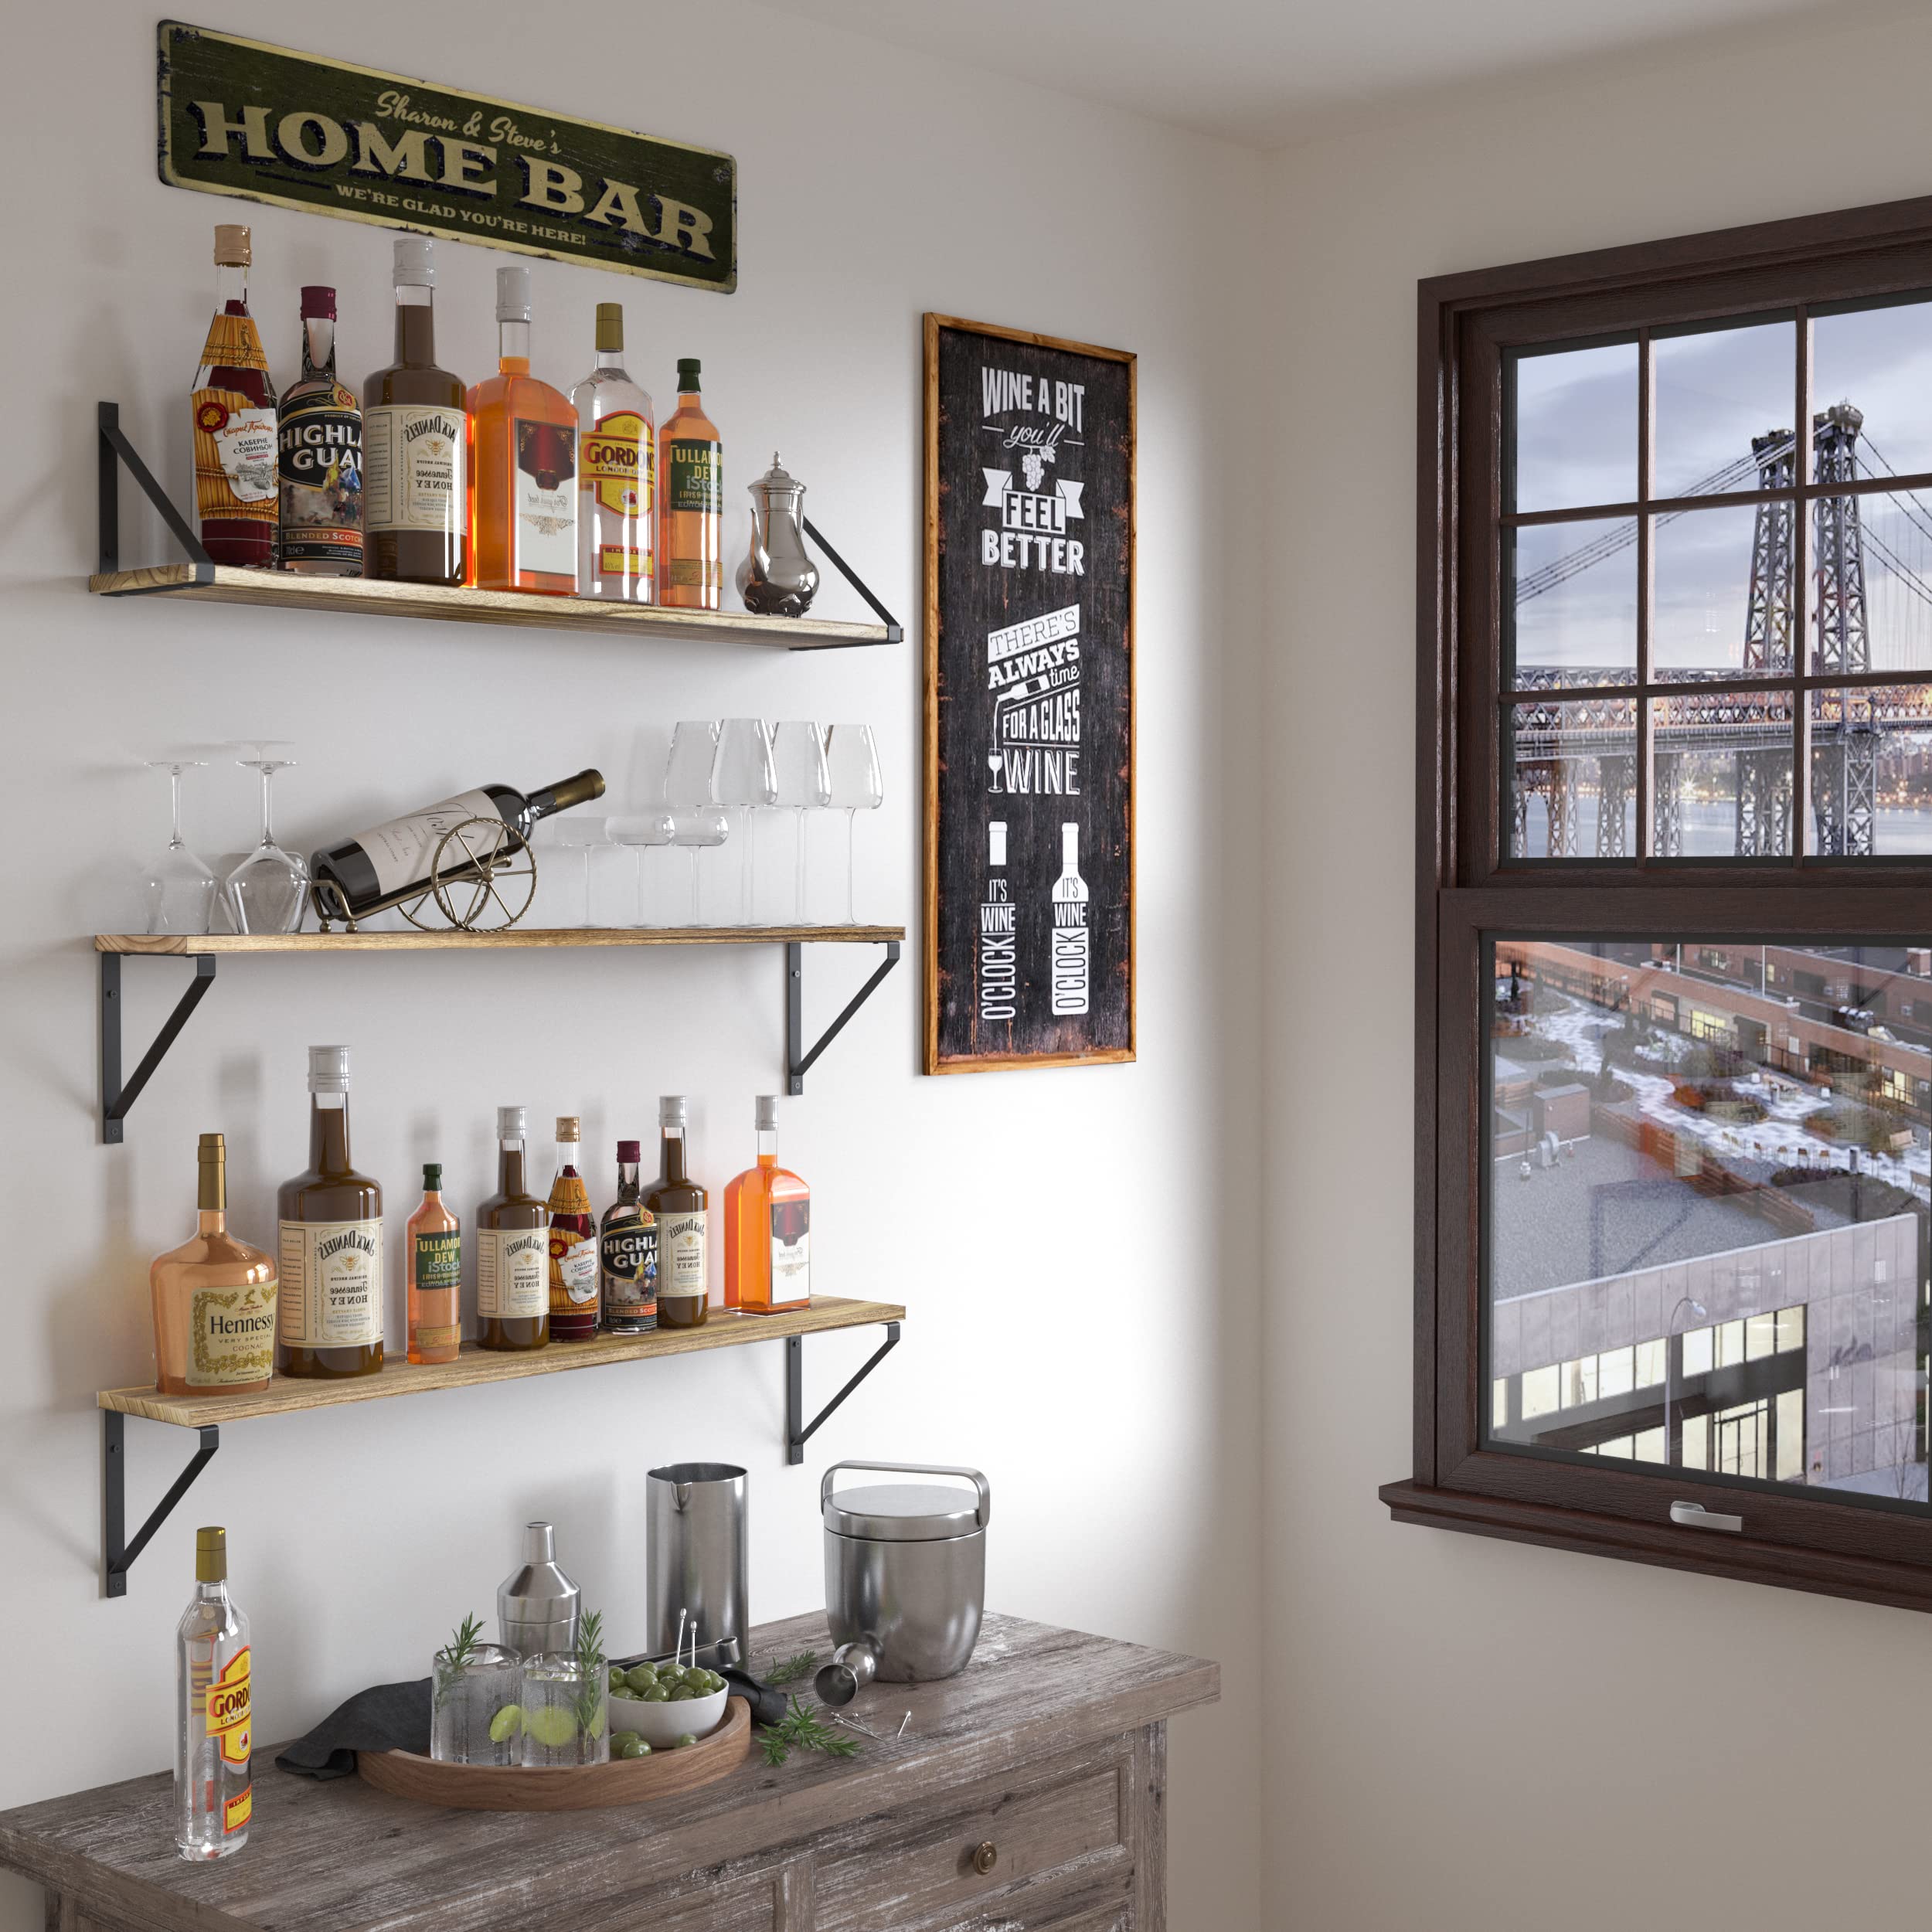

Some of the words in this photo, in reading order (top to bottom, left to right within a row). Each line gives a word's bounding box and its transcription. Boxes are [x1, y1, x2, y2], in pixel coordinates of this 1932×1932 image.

[375, 90, 457, 131] Sharon
[463, 111, 483, 137] &
[488, 117, 562, 155] Steve's
[192, 101, 497, 196] HOME
[515, 155, 717, 261] BAR
[335, 185, 399, 206] WE'RE
[403, 199, 455, 218] GLAD
[460, 209, 528, 232] YOU'RE
[531, 225, 586, 245] HERE!
[982, 366, 1032, 418] WINE
[1038, 378, 1050, 415] A
[1056, 381, 1085, 434] BIT
[233, 444, 273, 454] СОВИНЬОН
[238, 438, 268, 447] КАБЕРНЕ
[1003, 421, 1065, 449] you'll
[1006, 492, 1063, 532] FEEL
[982, 529, 1085, 577] BETTER
[991, 611, 1077, 656] THERE'S
[988, 638, 1080, 690] ALWAYS
[1049, 665, 1080, 687] time
[1003, 708, 1027, 739] FOR
[1029, 705, 1039, 740] A
[1041, 689, 1080, 742] GLASS
[1003, 749, 1080, 795] WINE
[989, 879, 1007, 902] IT'S
[1063, 877, 1078, 898] IT'S
[981, 906, 1015, 932] WINE
[1054, 903, 1086, 927] WINE
[981, 936, 1015, 1019] O'CLOCK
[1056, 931, 1085, 1009] O'CLOCK
[435, 1251, 455, 1264] DEW
[210, 1312, 274, 1335] Hennessy
